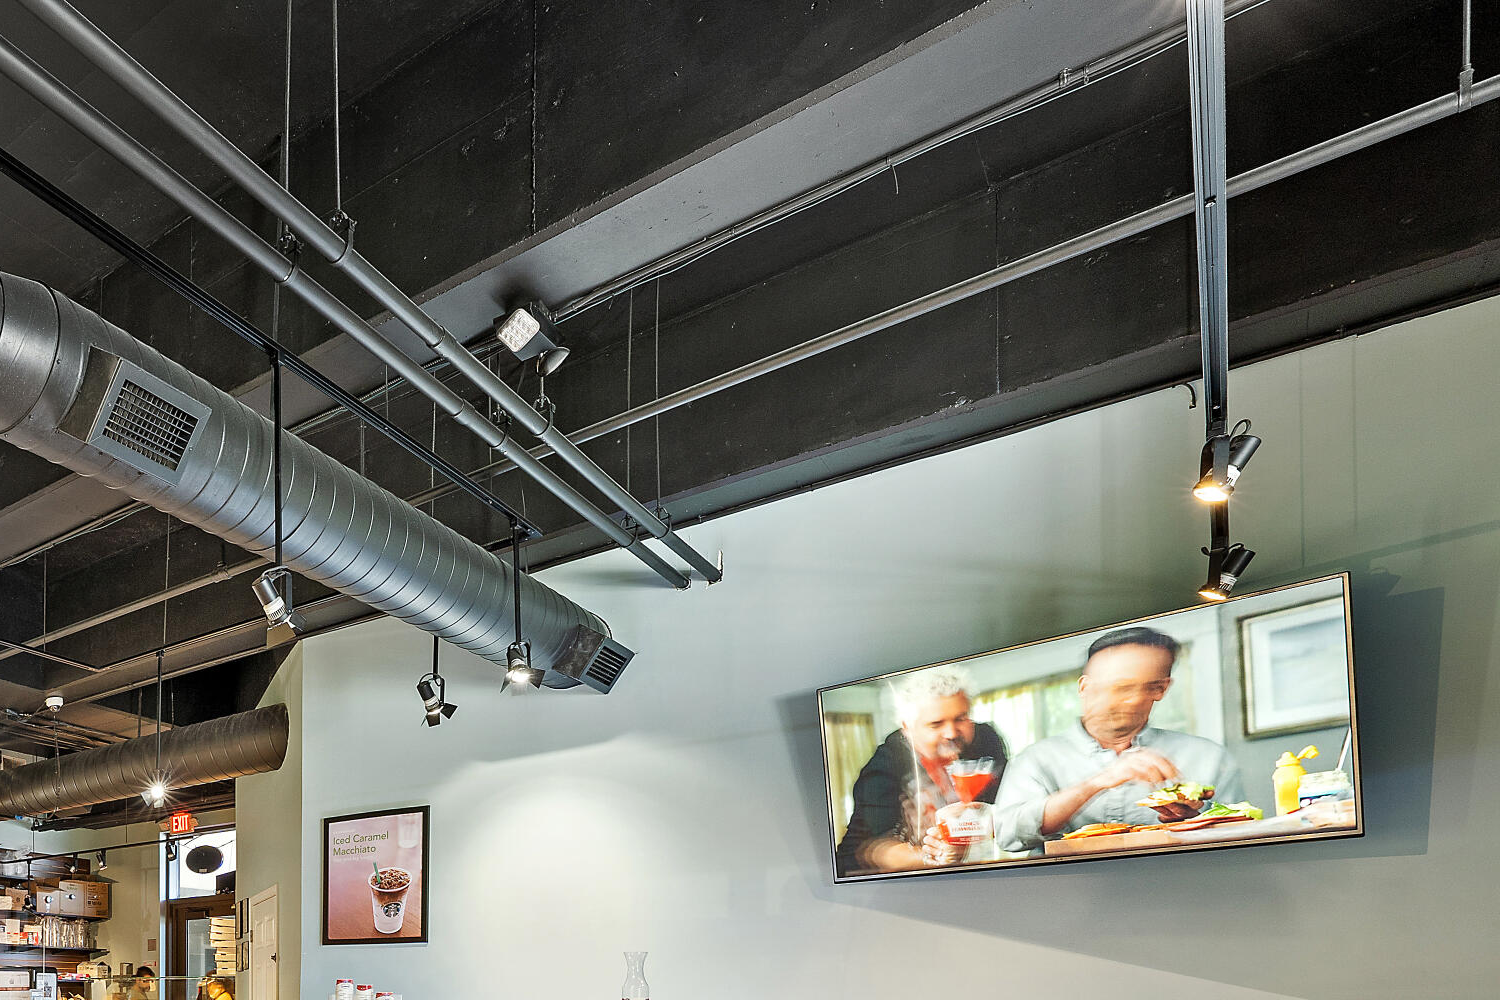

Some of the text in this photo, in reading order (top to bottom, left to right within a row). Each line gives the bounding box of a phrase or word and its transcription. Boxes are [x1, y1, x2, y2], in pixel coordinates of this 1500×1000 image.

[172, 815, 188, 831] EXIT
[333, 835, 350, 845] Iced
[353, 831, 389, 843] Caramel
[333, 845, 376, 856] Macchiato
